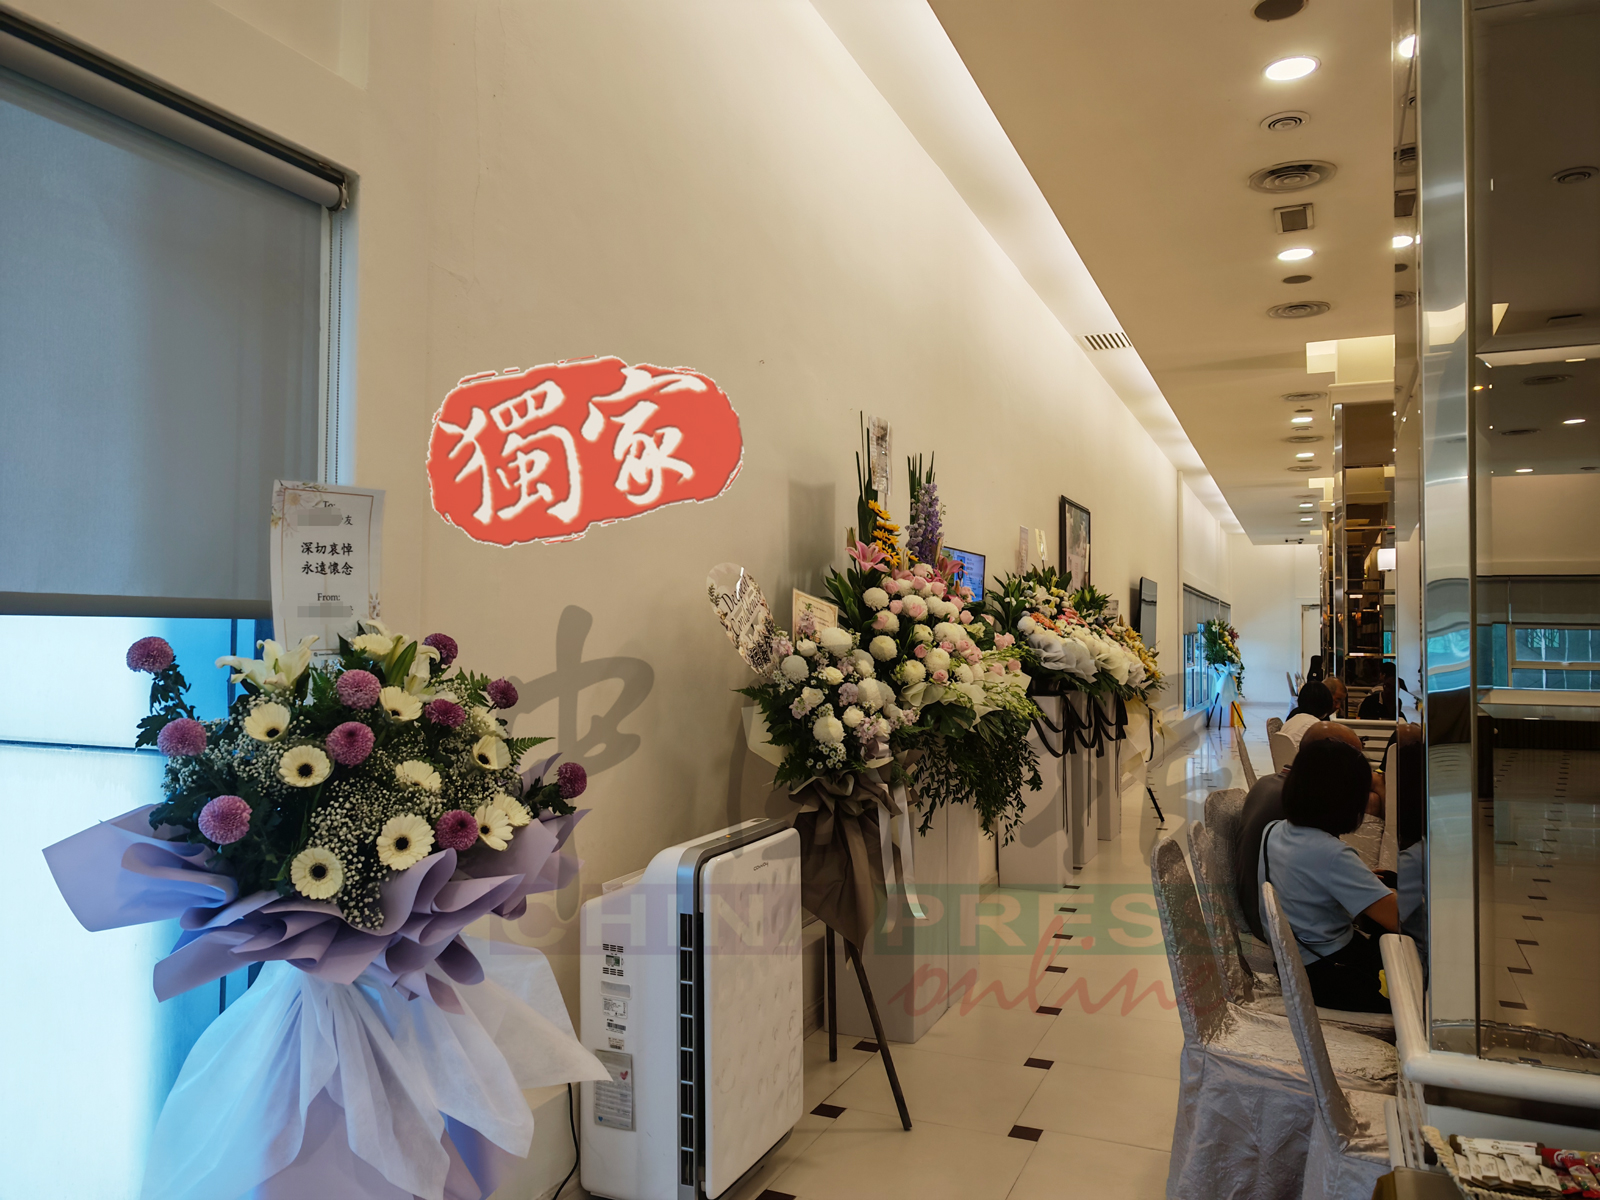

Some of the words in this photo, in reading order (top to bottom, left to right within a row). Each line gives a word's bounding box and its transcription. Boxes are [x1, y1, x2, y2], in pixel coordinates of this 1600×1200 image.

[301, 541, 354, 556] 深切哀悼
[301, 561, 354, 576] 永遠懷念
[317, 592, 341, 601] From:
